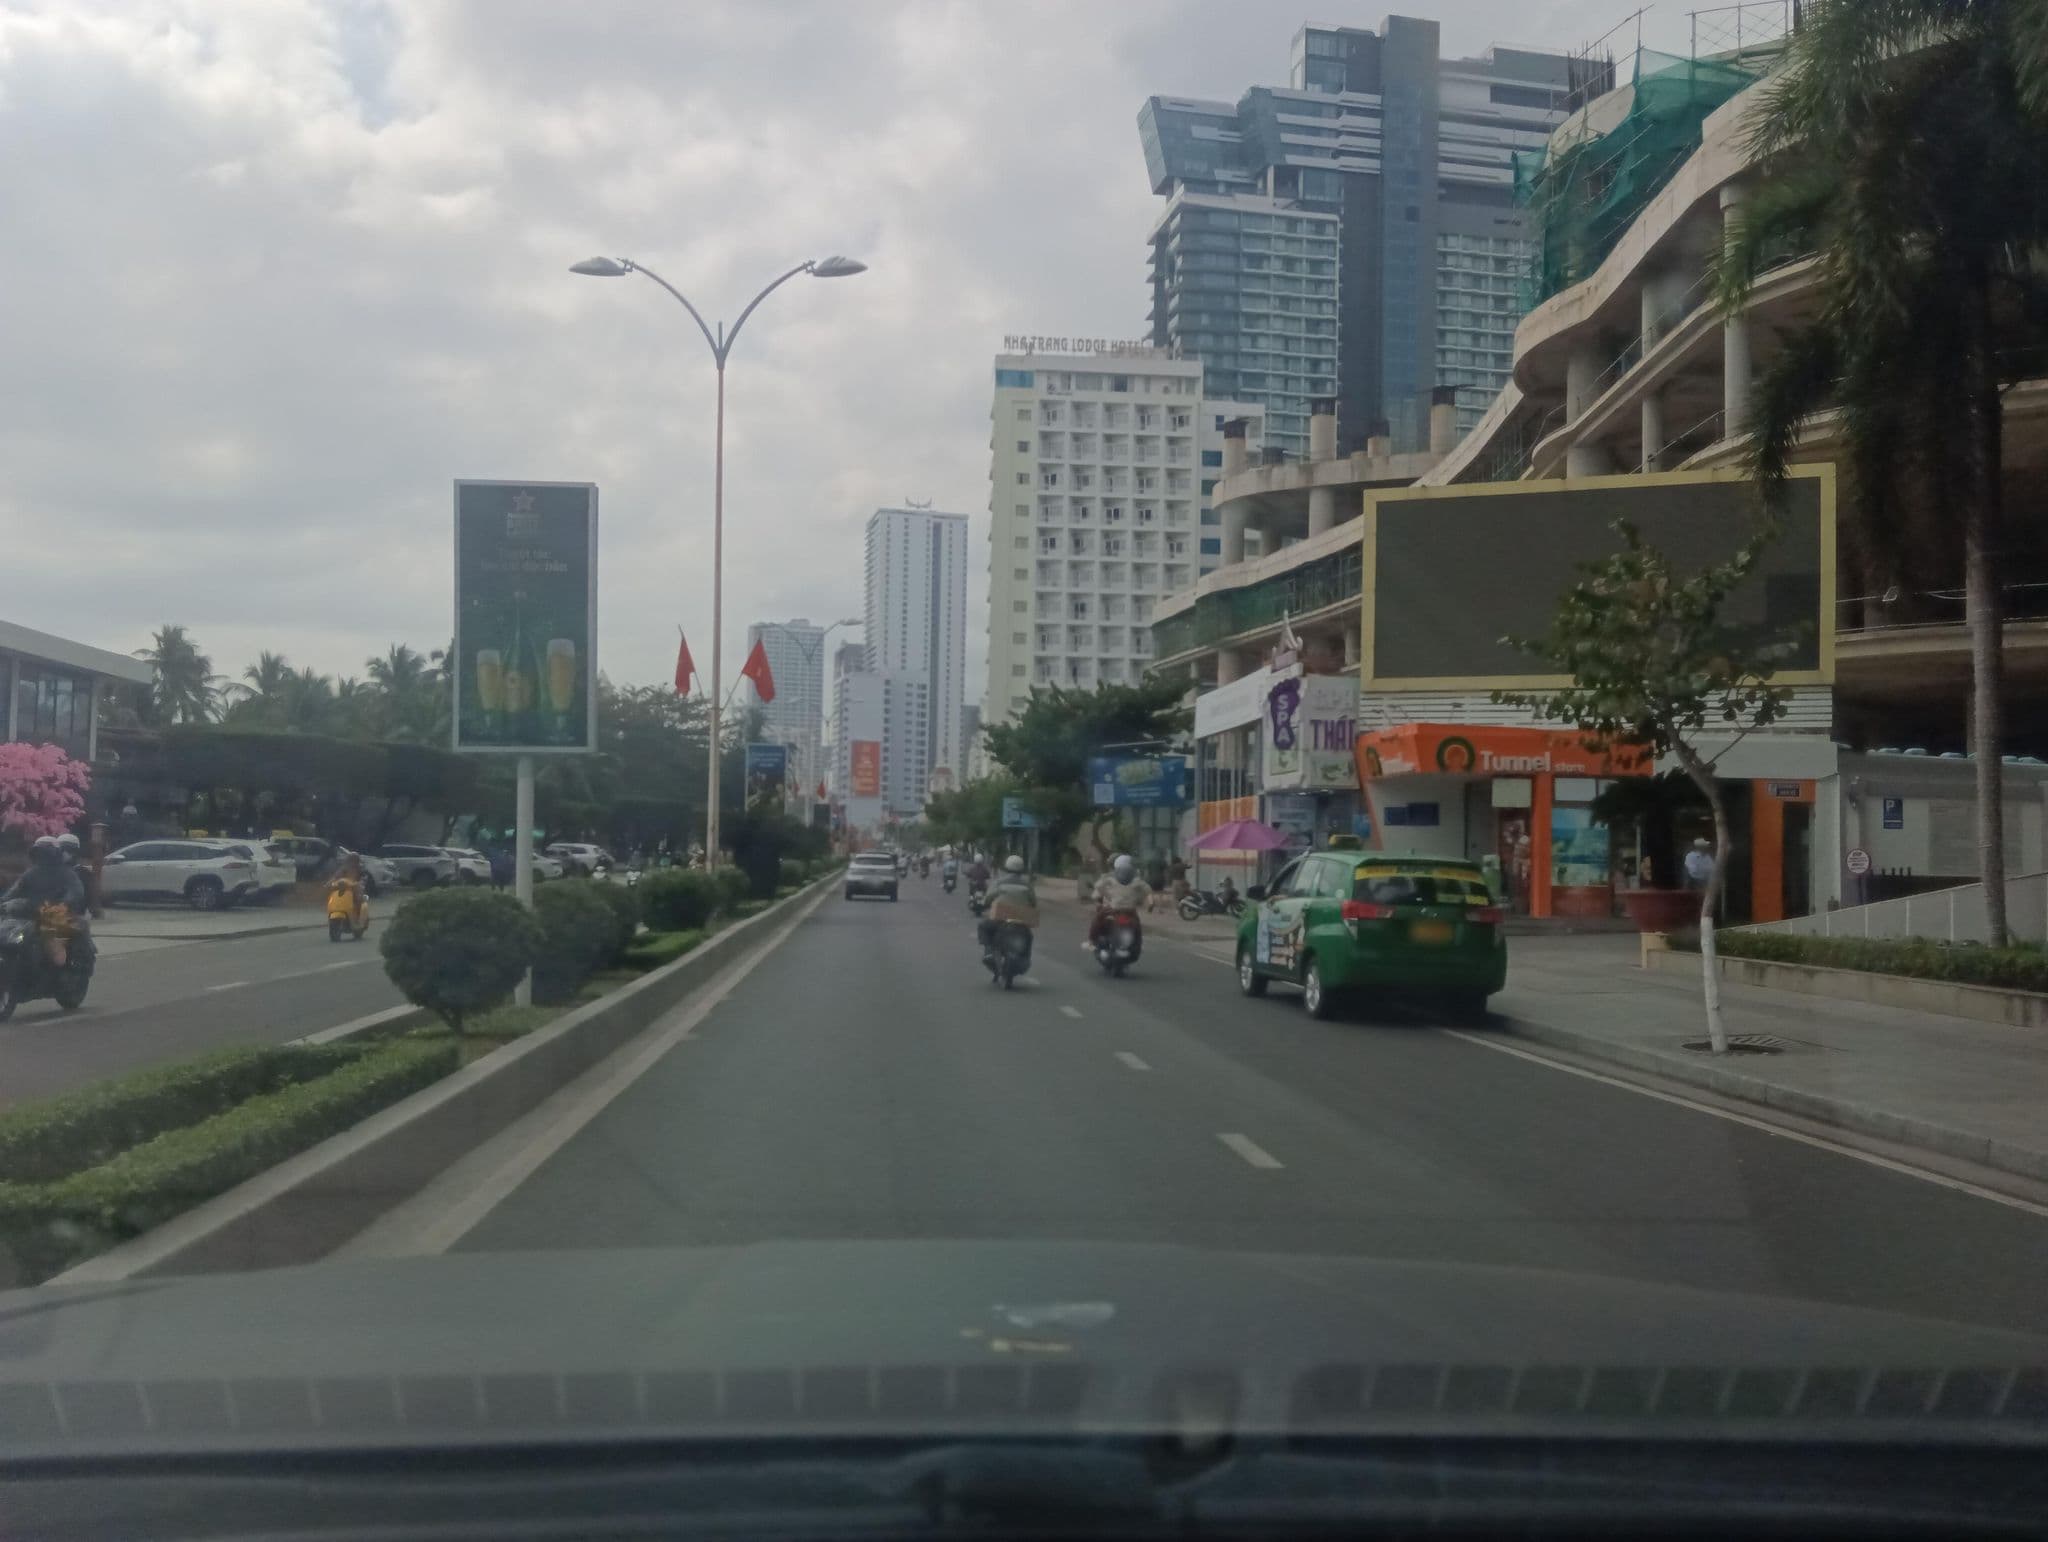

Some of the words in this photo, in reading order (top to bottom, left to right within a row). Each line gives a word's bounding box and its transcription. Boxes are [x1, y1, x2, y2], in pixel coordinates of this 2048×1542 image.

[1003, 335, 1026, 351] NHA
[1031, 336, 1069, 352] TRANG
[1072, 337, 1106, 353] LODGE
[1277, 695, 1291, 742] SPA
[1480, 750, 1551, 773] Tunnel
